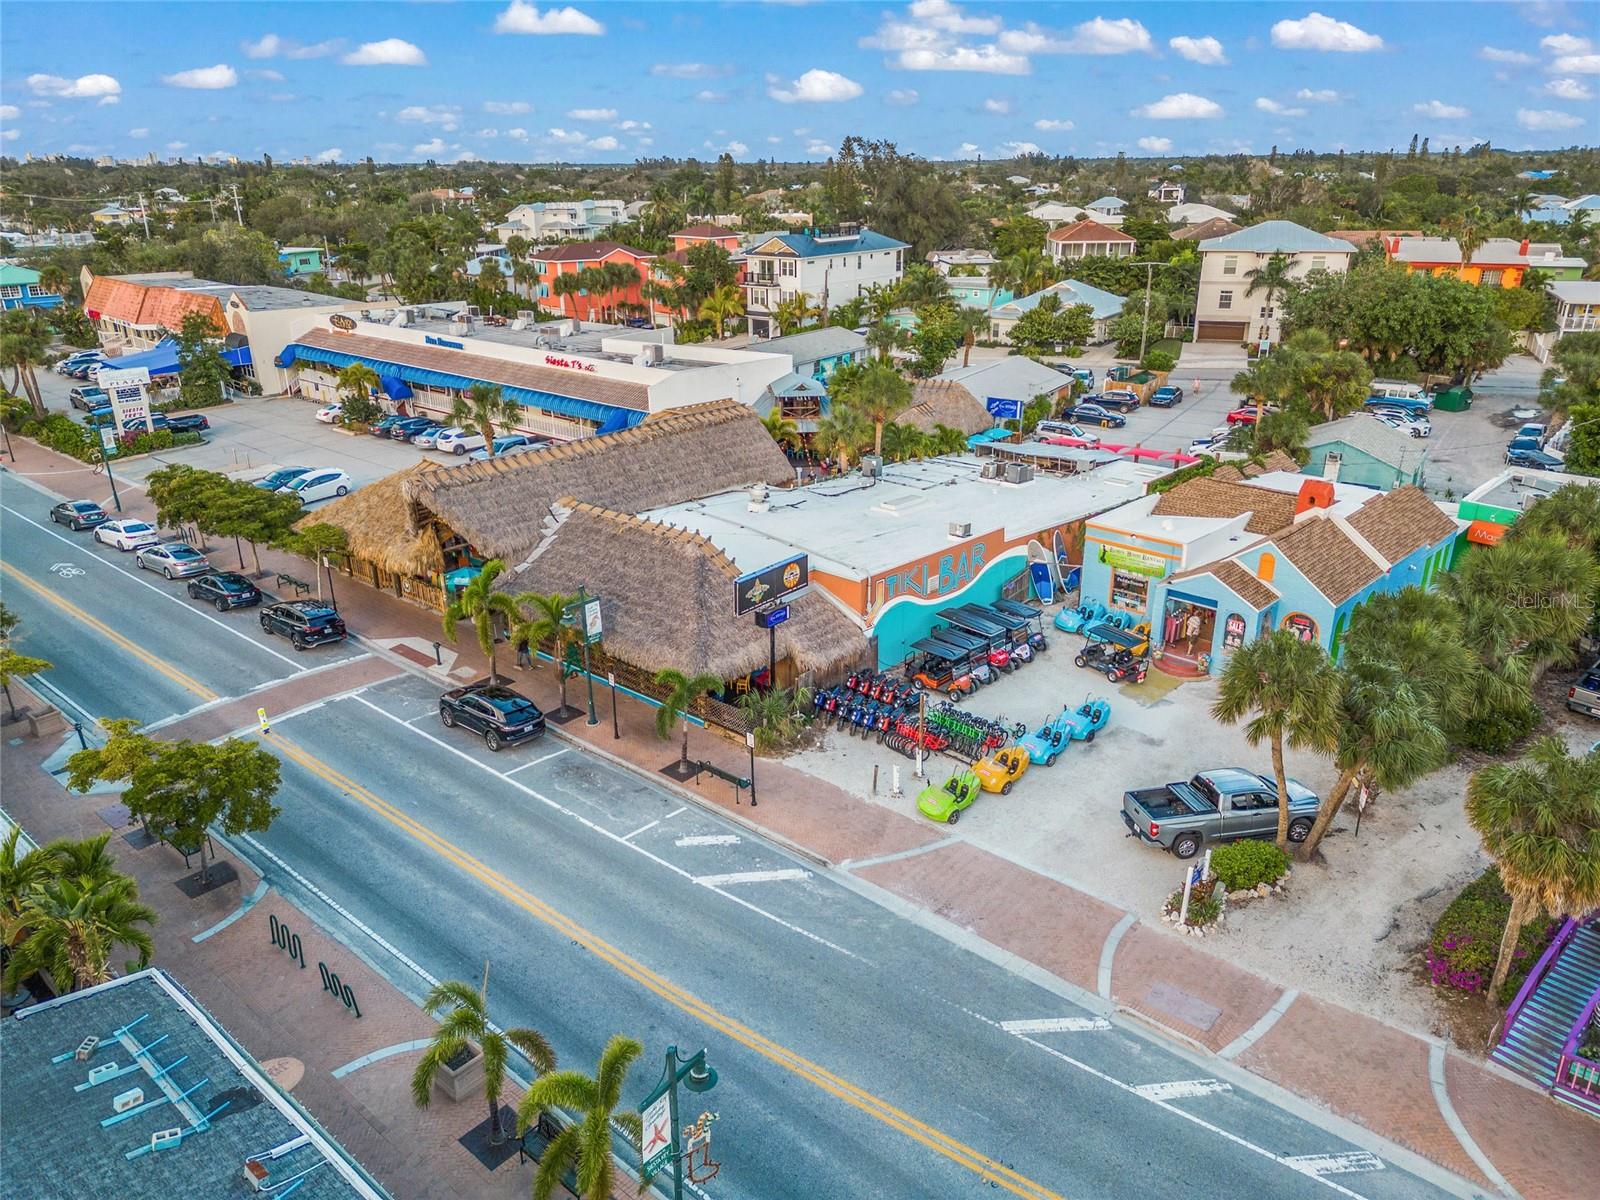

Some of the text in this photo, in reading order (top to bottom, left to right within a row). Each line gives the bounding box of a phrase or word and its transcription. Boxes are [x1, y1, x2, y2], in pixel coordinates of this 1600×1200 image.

[545, 355, 569, 368] Siesta
[885, 541, 987, 600] TIKI BAR
[1227, 620, 1245, 633] SALE
